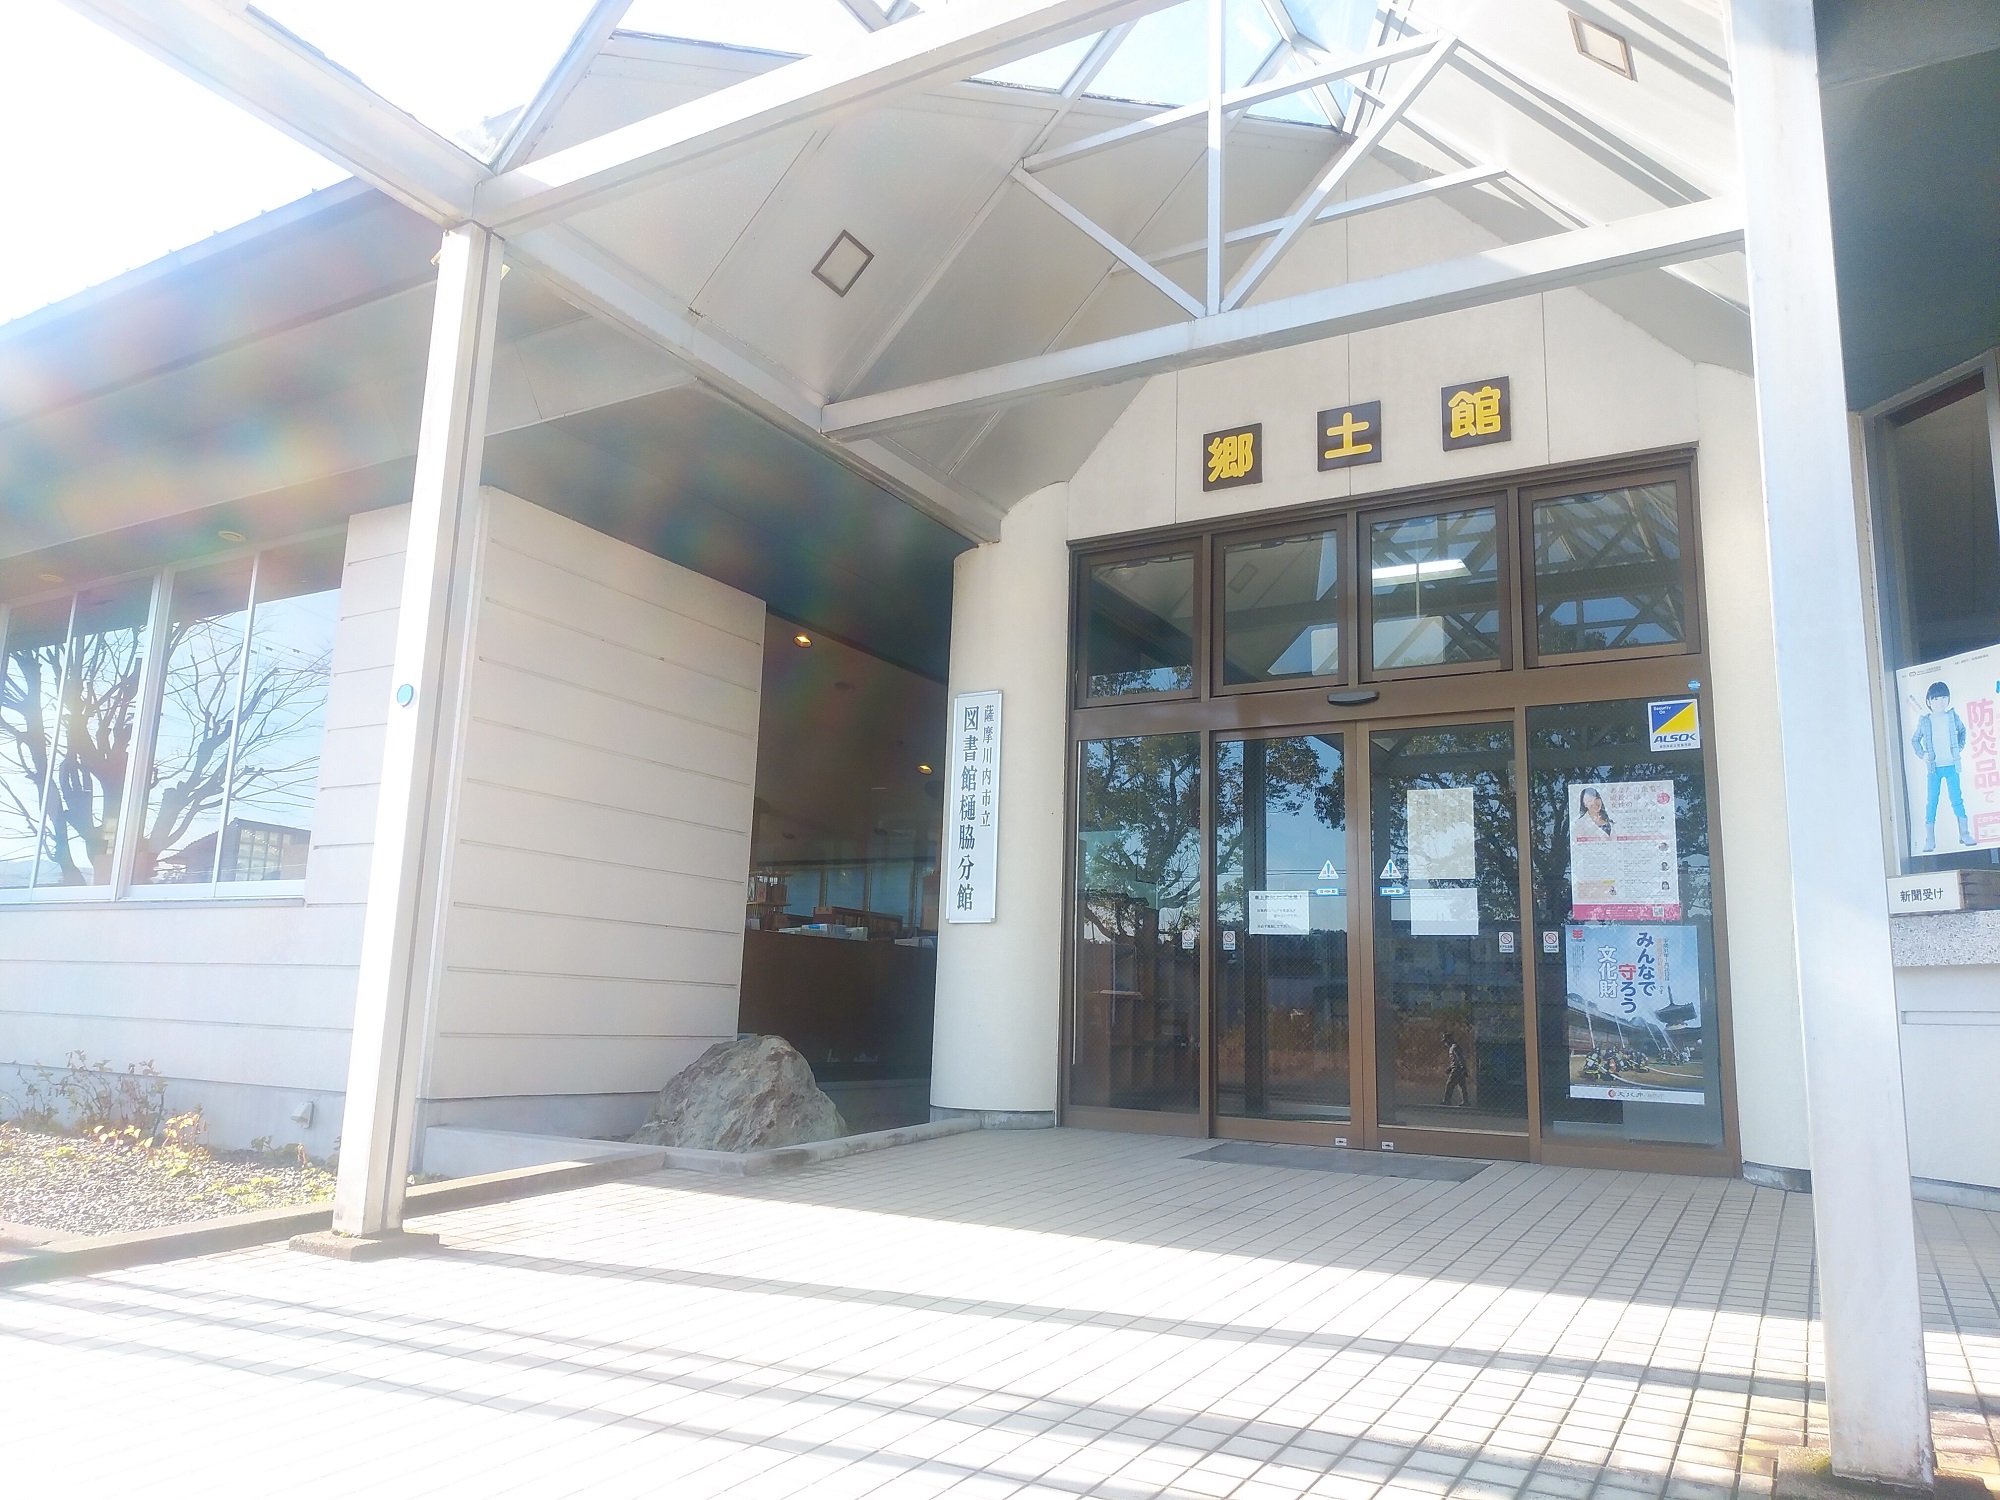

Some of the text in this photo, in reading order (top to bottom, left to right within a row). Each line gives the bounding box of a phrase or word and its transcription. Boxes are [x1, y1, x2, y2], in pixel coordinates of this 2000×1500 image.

[1653, 733, 1697, 744] ALSOK
[980, 704, 995, 828] 薩摩川内市立
[957, 705, 980, 912] 図書館樋脇分館
[1899, 887, 1944, 903] 新聞受け
[1598, 945, 1618, 998] 文化財
[1618, 963, 1637, 1014] 守ろう
[1636, 932, 1656, 997] みんなで
